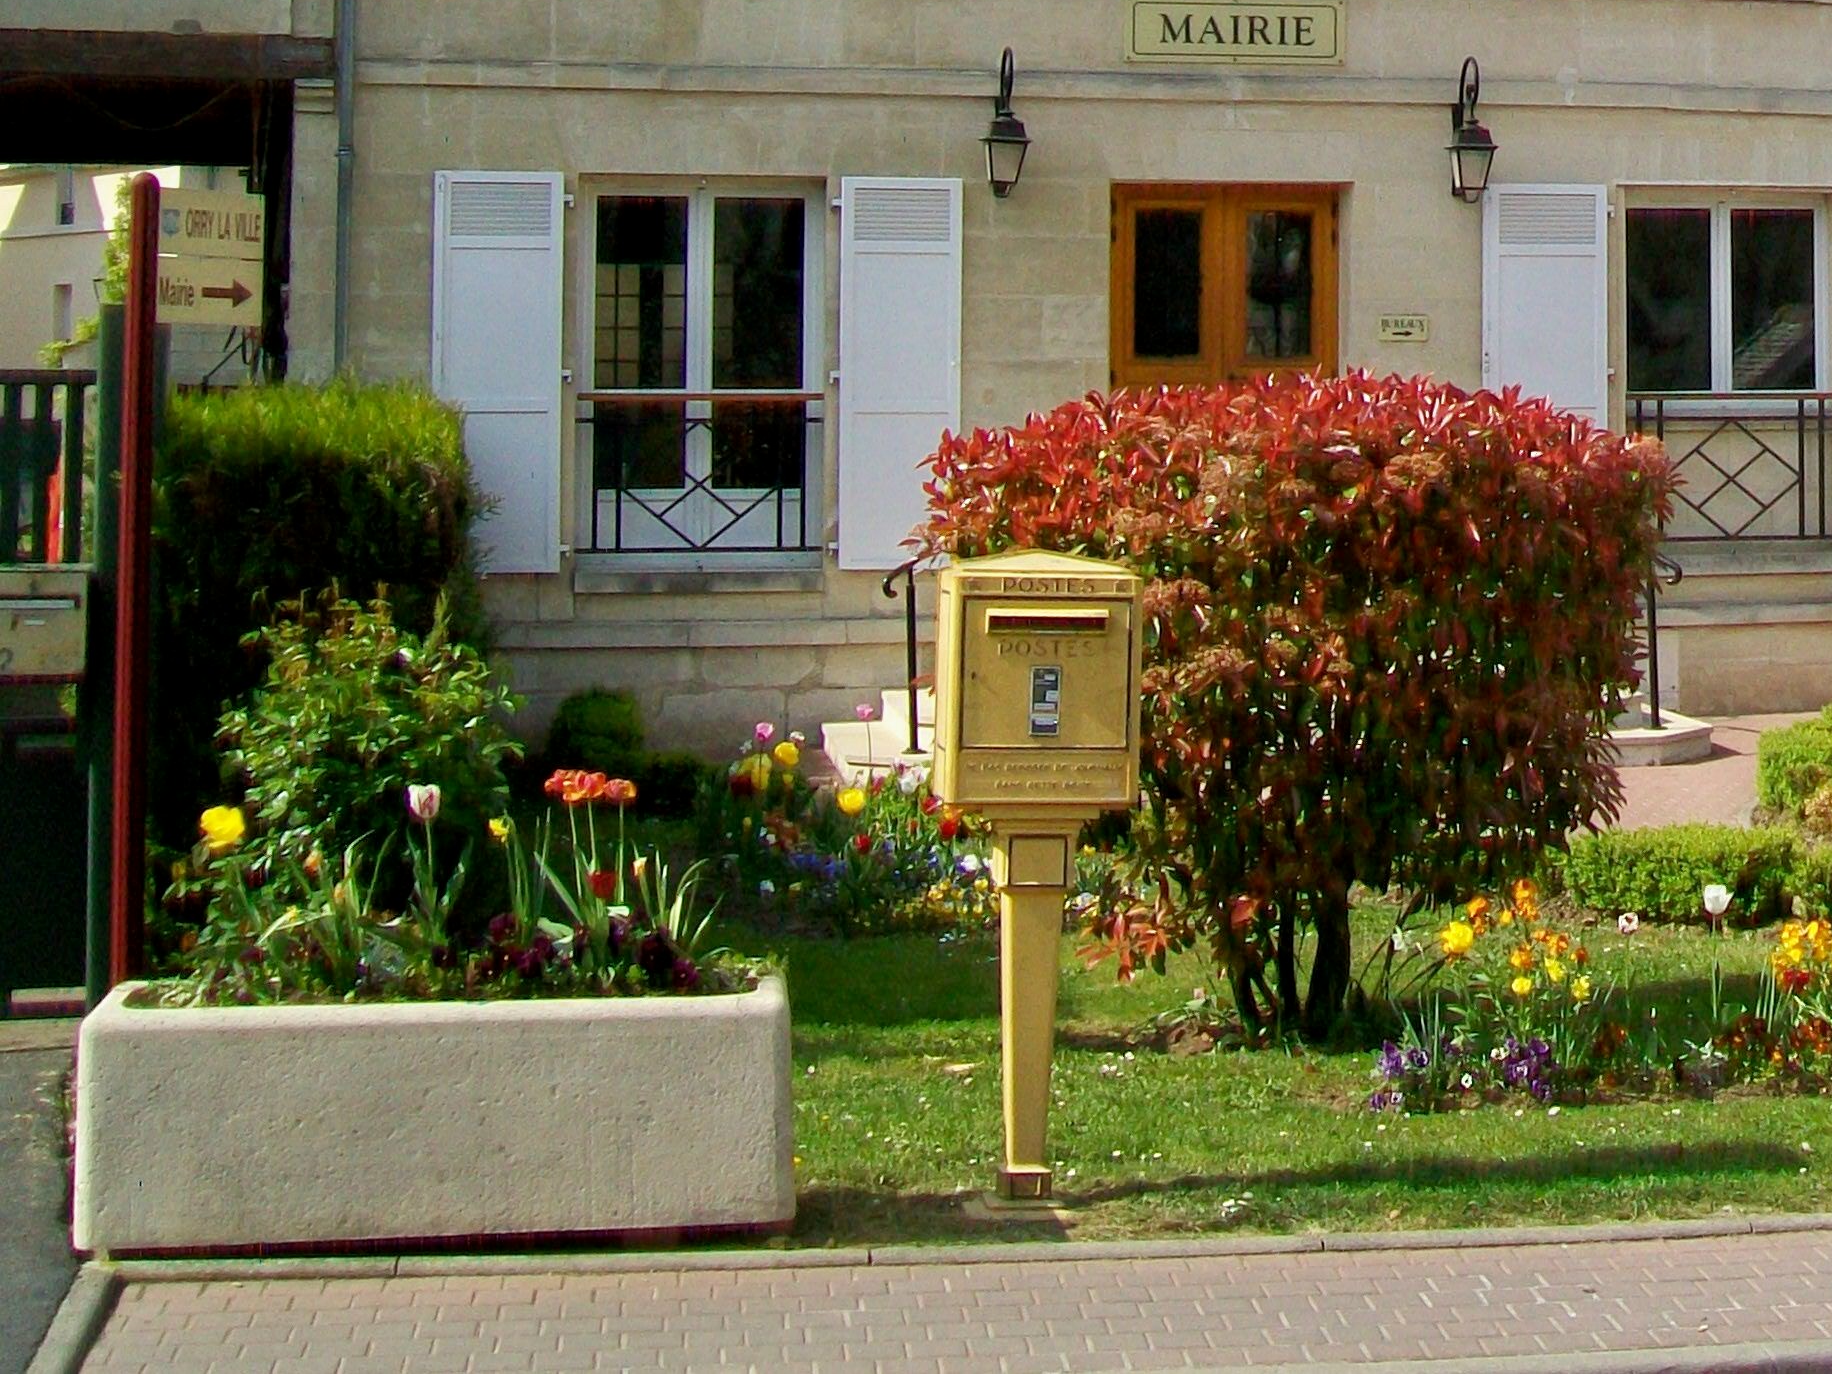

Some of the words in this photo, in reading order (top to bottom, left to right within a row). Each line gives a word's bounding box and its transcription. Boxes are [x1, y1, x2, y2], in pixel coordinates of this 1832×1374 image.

[1159, 13, 1316, 46] MAIRIE
[185, 208, 214, 238] ORRY
[218, 211, 231, 240] LA
[235, 213, 261, 242] VILLE
[159, 277, 195, 307] Mairie
[1001, 577, 1095, 593] POSTES
[998, 638, 1096, 659] POSTES
